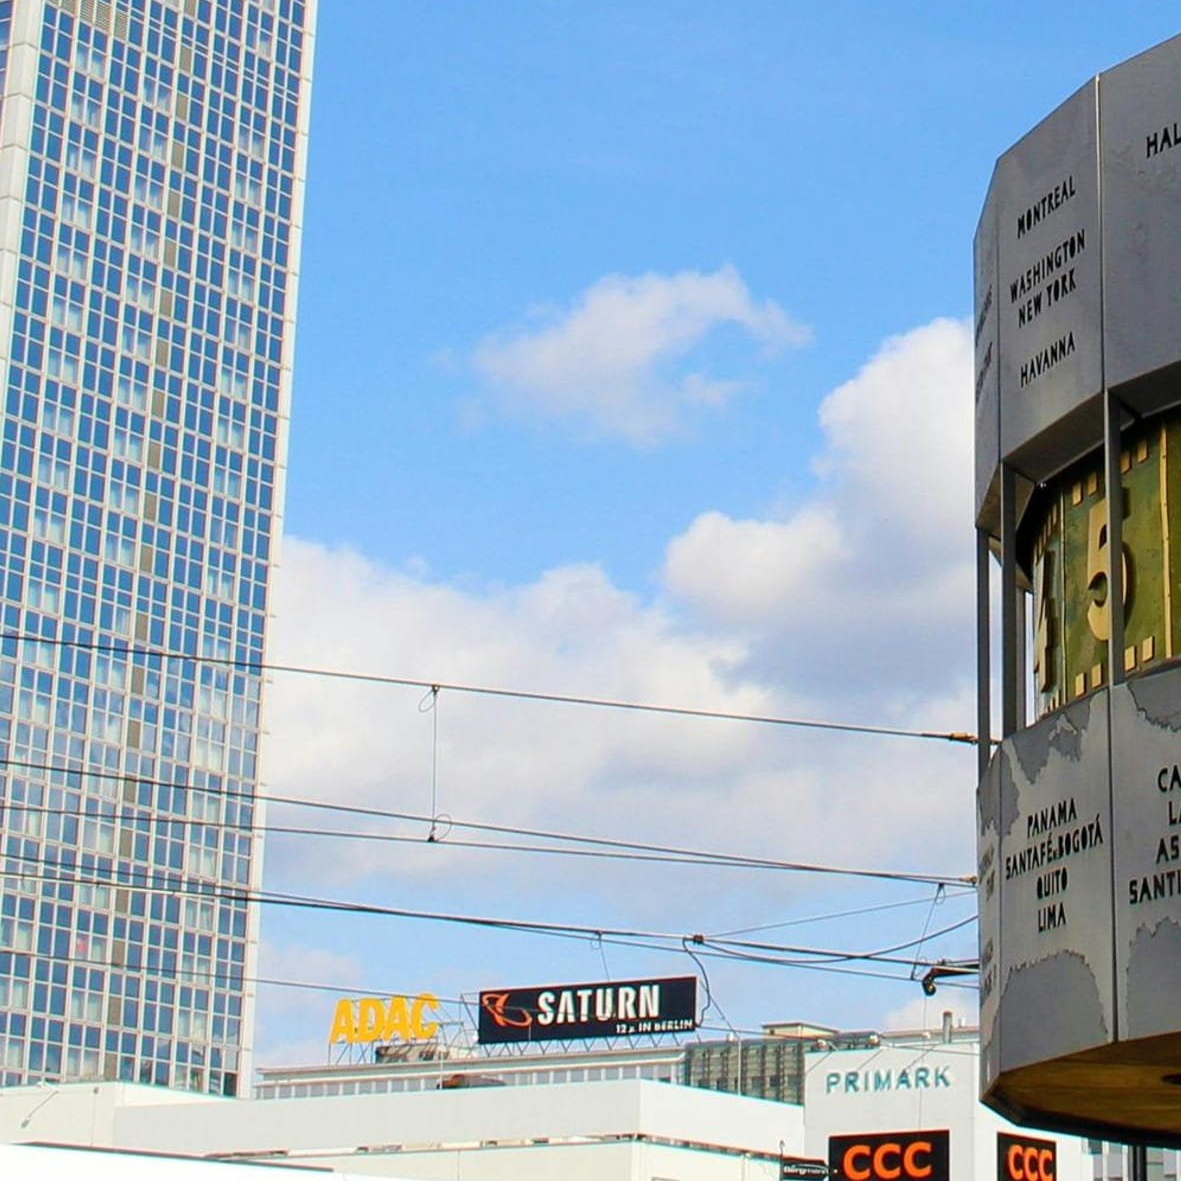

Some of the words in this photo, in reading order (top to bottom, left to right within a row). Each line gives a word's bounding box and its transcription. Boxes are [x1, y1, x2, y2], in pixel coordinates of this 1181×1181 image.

[1017, 175, 1076, 240] MONTREAL
[1010, 229, 1085, 304] WASHINGTON
[1018, 292, 1042, 329] NEW
[1046, 267, 1077, 307] YORK
[1020, 330, 1076, 388] HAVANNA
[1027, 797, 1077, 839] PANAMA
[1037, 867, 1067, 899] QUITO
[1038, 903, 1066, 932] LIMA
[330, 993, 439, 1044] ADAC
[537, 984, 660, 1026] SATURN
[638, 1021, 652, 1032] IN
[654, 1018, 693, 1031] BERLIN
[826, 1065, 951, 1094] PRIMARK
[843, 1140, 932, 1181] CCC
[1008, 1144, 1053, 1181] CCC
